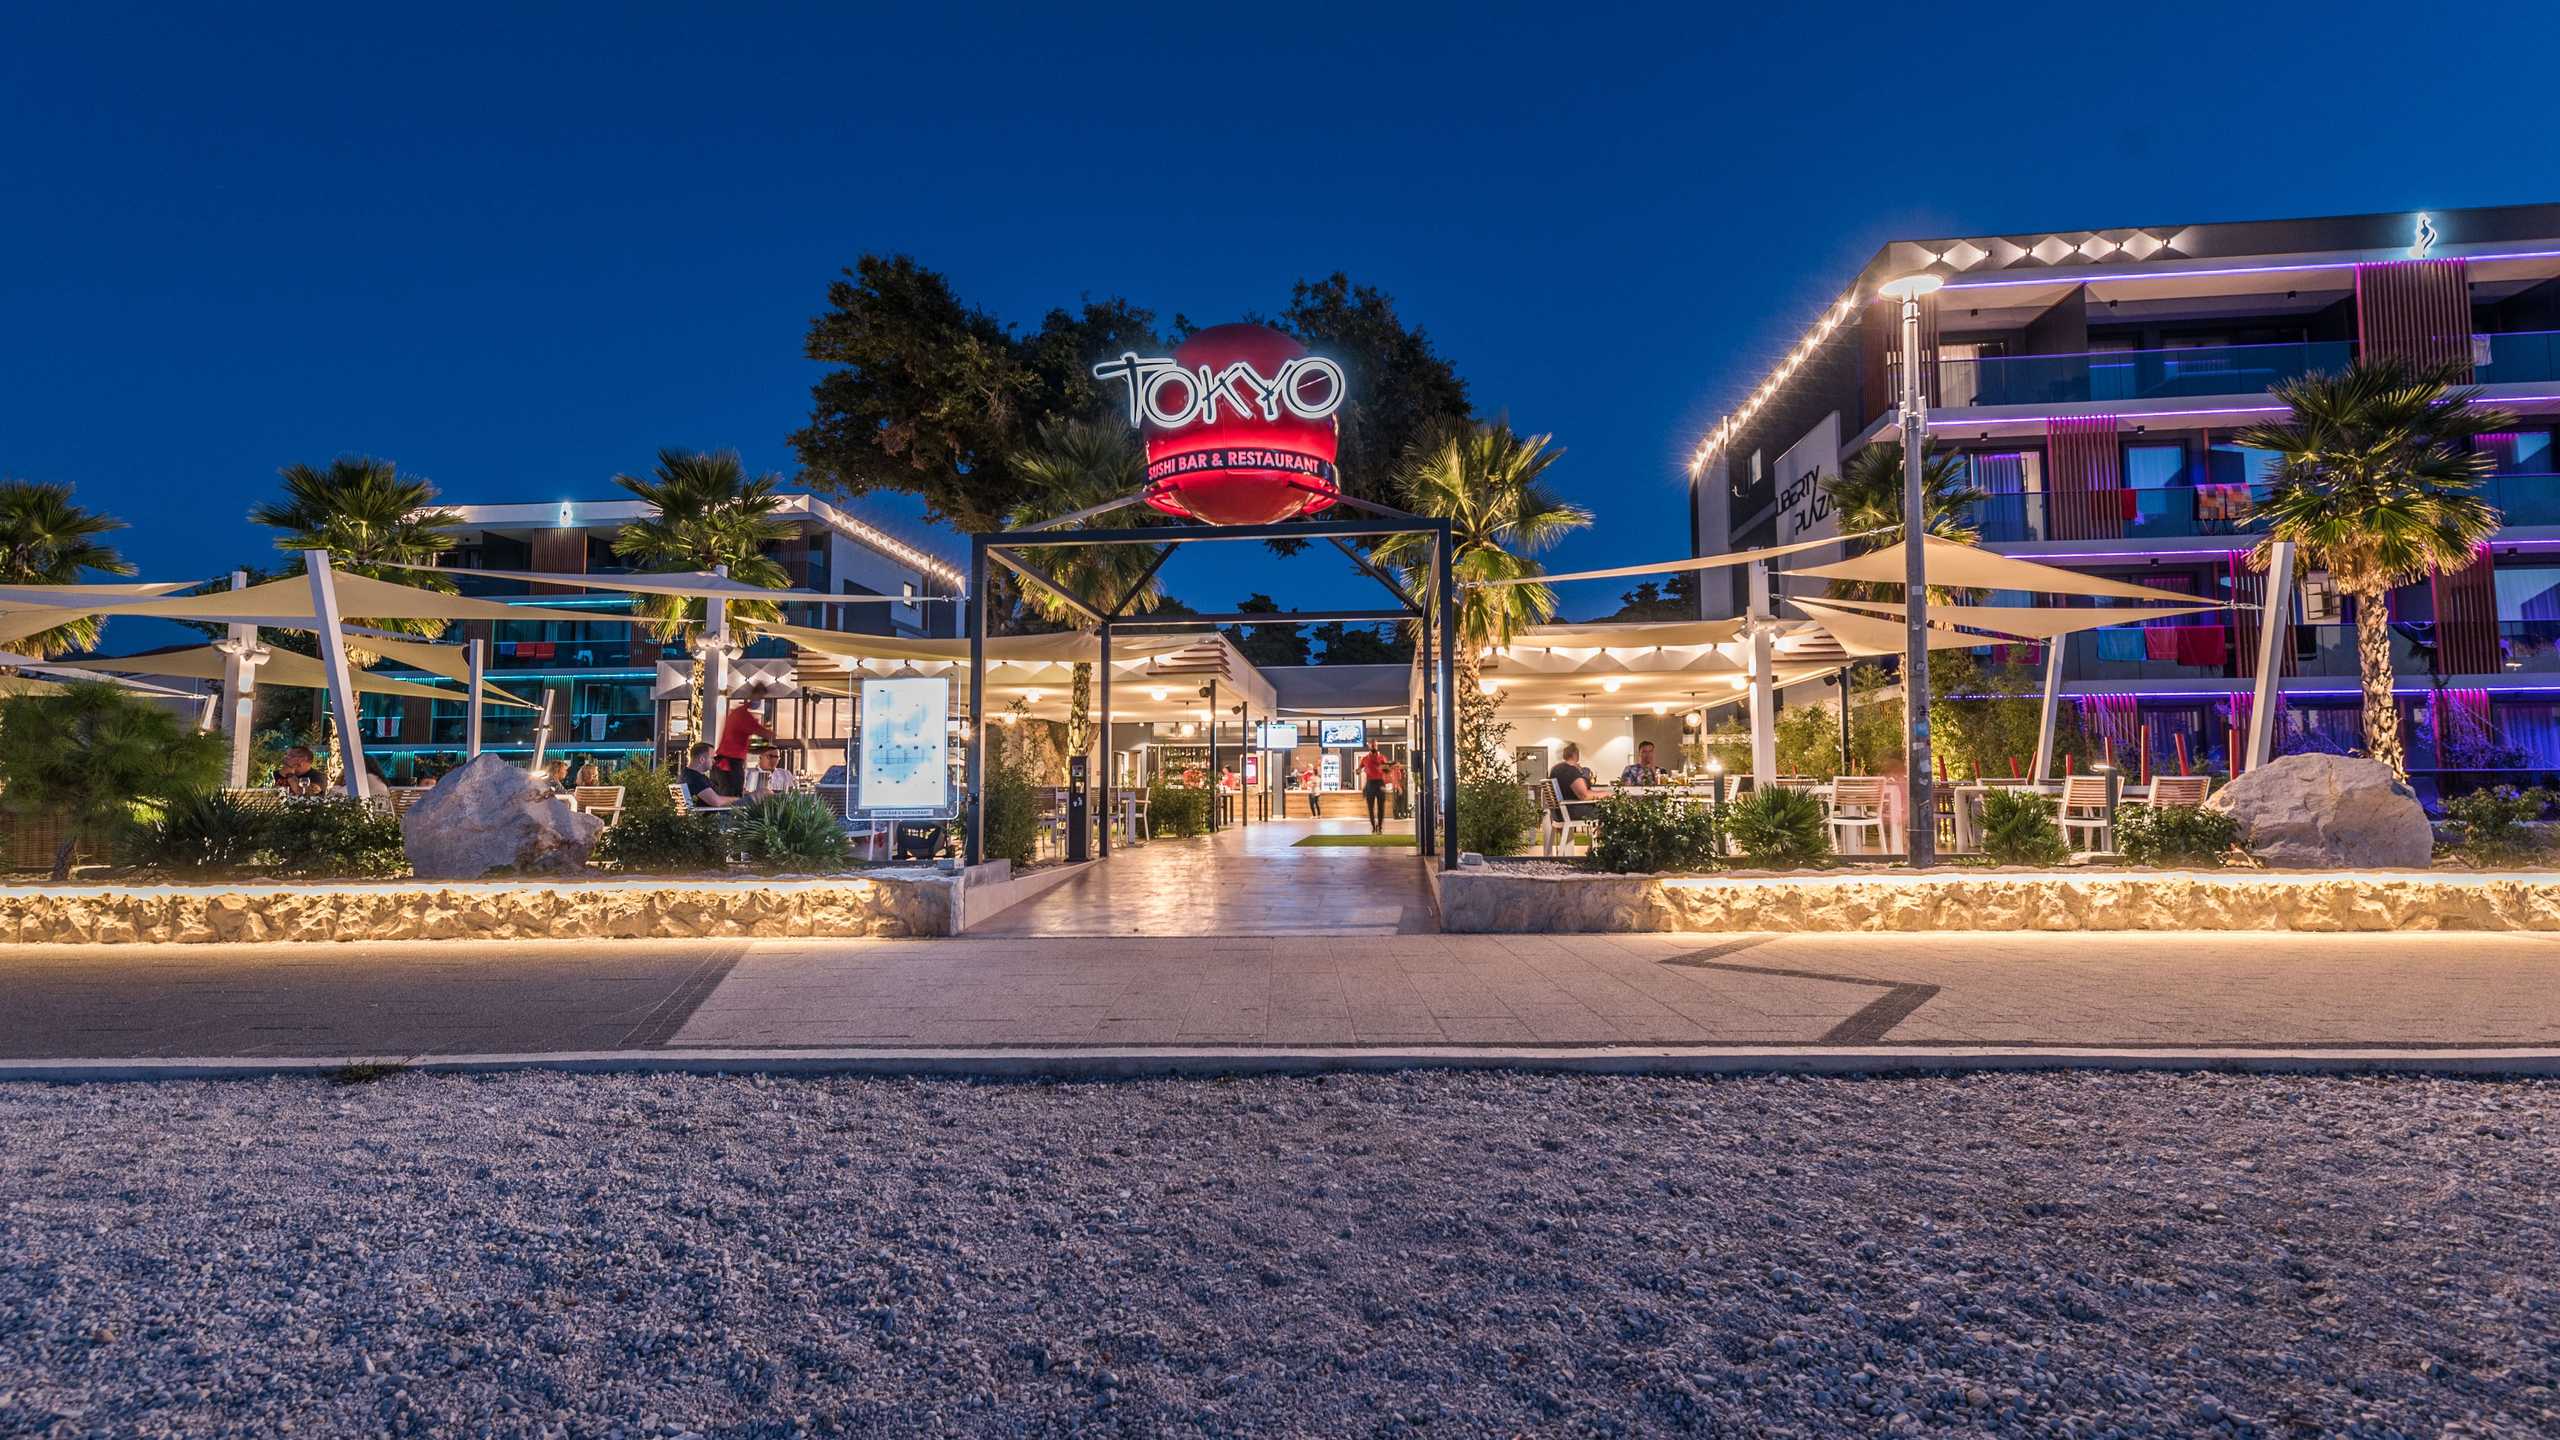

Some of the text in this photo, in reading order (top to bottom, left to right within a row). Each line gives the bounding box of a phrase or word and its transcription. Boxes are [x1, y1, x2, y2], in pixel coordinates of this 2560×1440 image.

[1093, 352, 1346, 429] TOKYO
[1148, 451, 1319, 480] SUSHI BAR & RESTAURANT
[1775, 465, 1820, 518] LIBERTY
